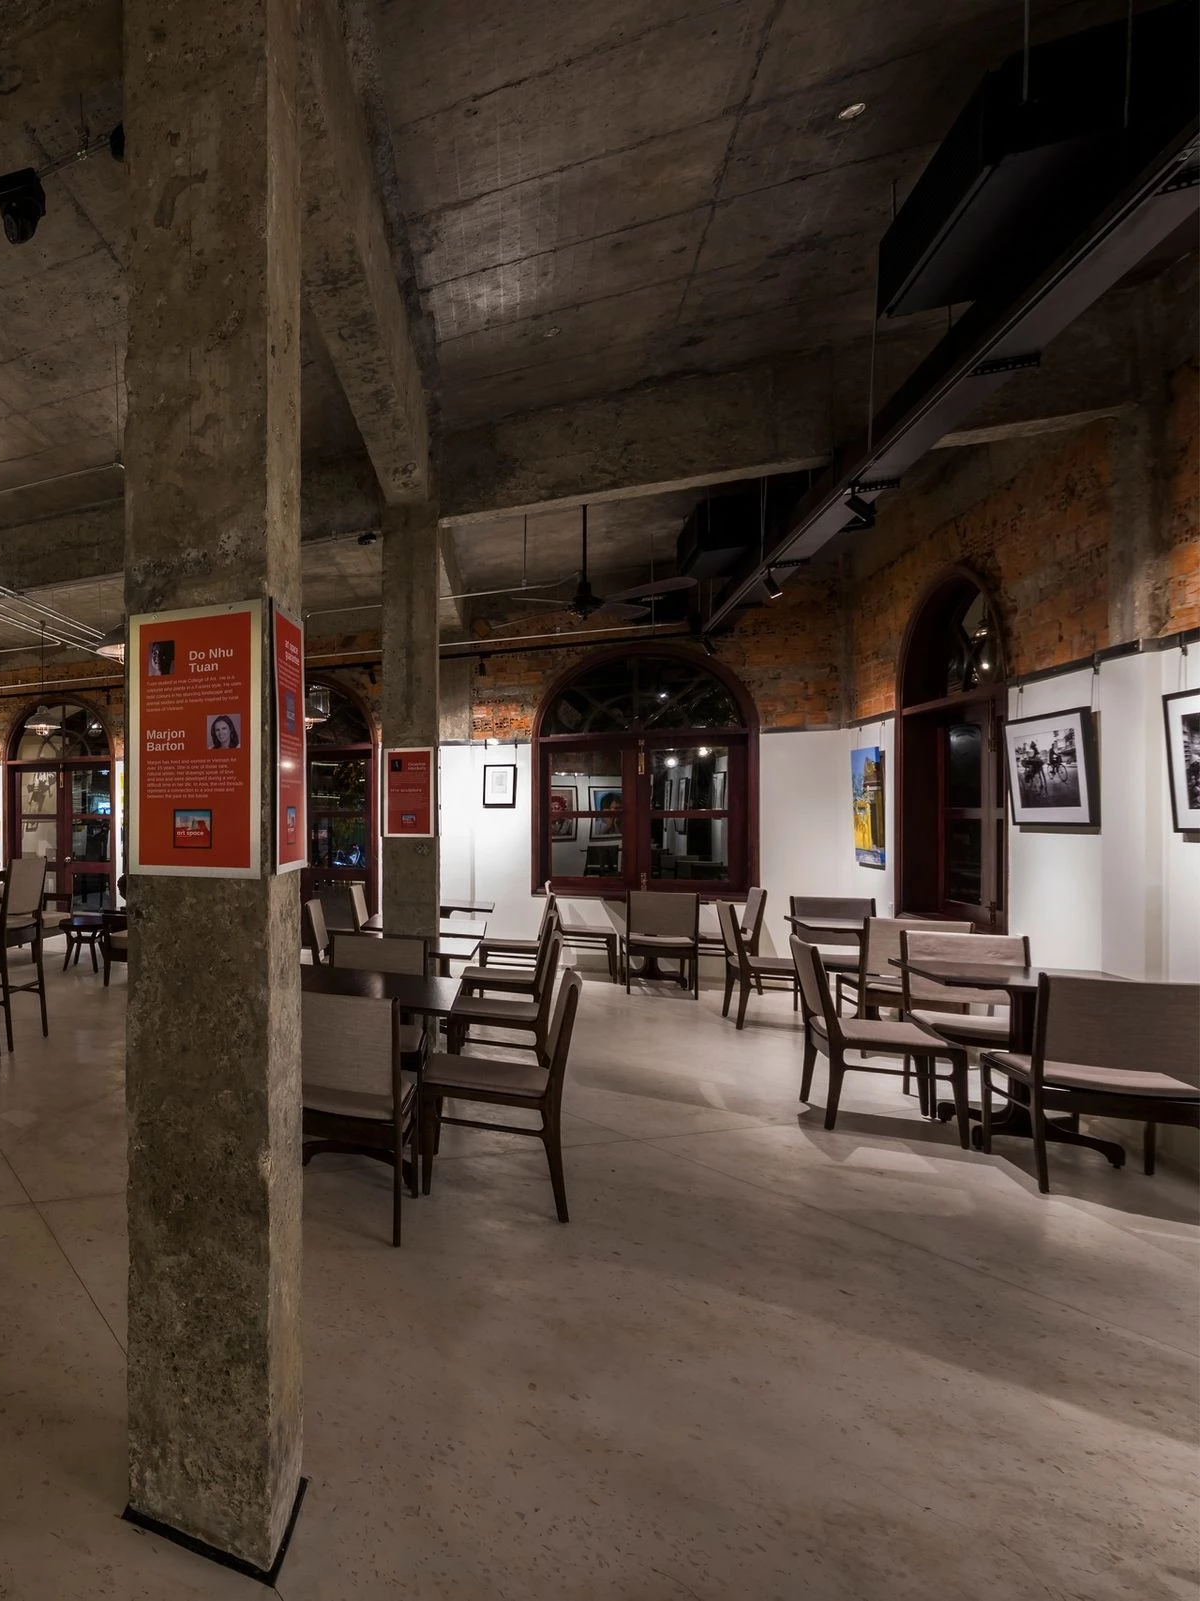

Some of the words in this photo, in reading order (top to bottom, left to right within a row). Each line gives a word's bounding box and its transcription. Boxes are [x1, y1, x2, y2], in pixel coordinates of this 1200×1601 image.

[189, 650, 205, 660] Do
[209, 648, 233, 659] Nhu
[189, 663, 219, 672] Tuan
[146, 728, 185, 741] Marjon
[146, 742, 185, 752] Barton
